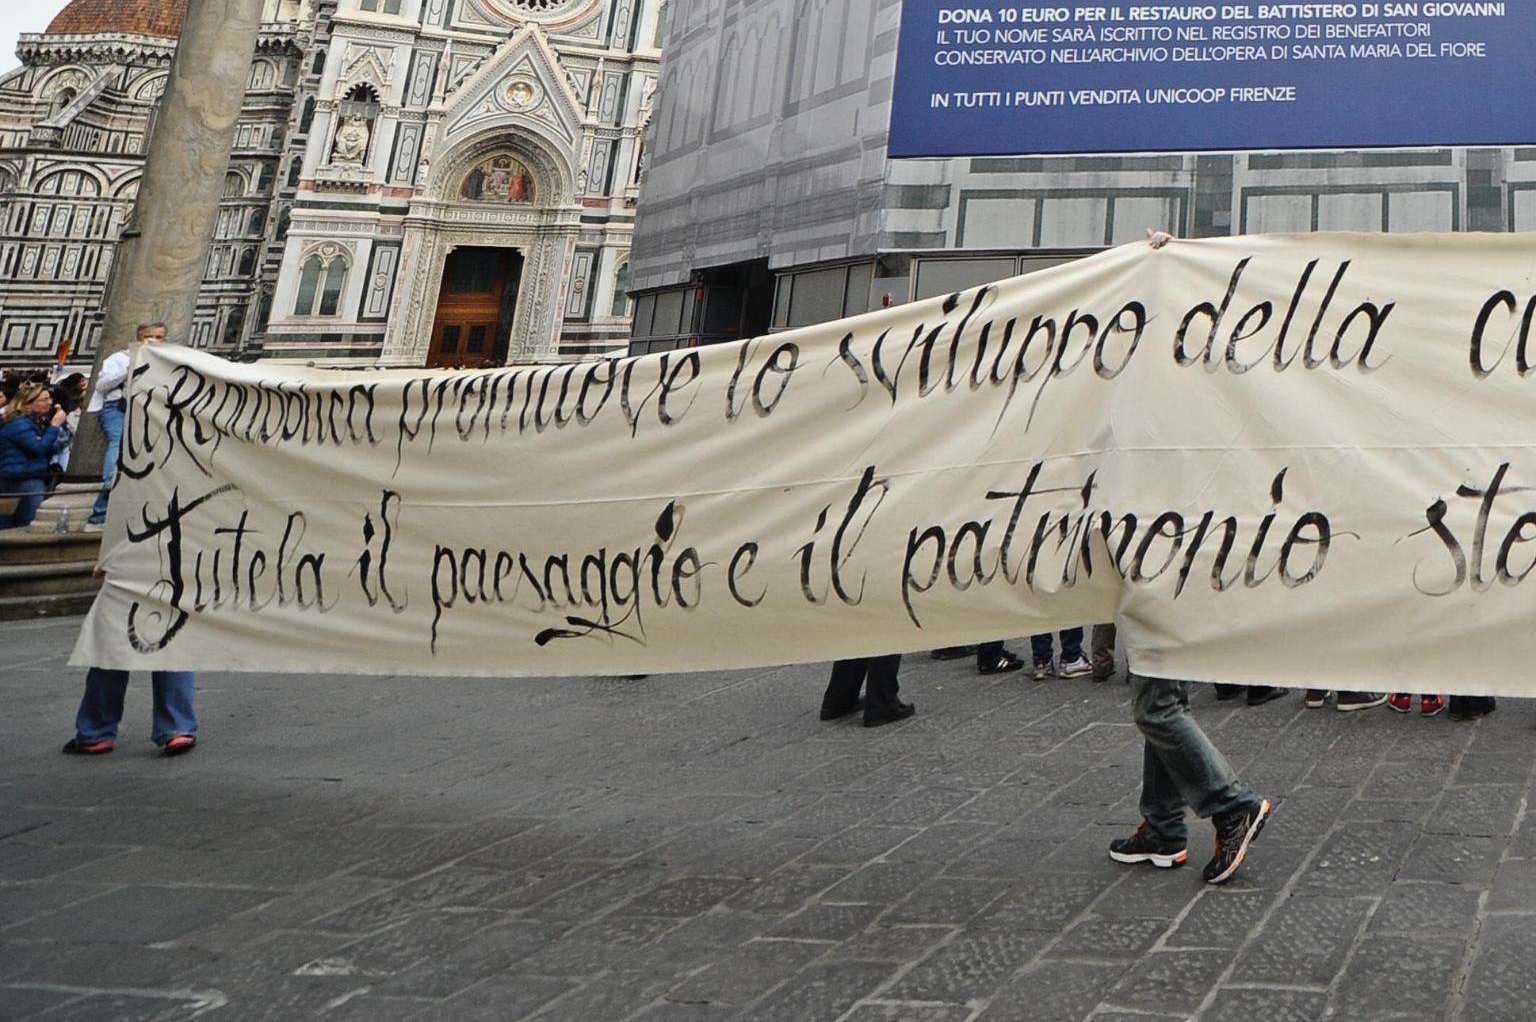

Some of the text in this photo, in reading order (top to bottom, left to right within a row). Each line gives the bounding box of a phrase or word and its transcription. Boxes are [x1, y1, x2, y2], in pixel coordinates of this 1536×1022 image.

[938, 2, 1505, 24] DONA 10 EURO PER IL RESTAURO DEL BATTISTERO DI SAN GIOVANNI
[936, 23, 1430, 45] IL TUO NOME SARÀ ISCRITTO NEL REGISTRO DEI BENEFATTORI
[934, 42, 1486, 66] CONSERVATO NELL'ARCHIVIO DELL'OPERA DI SANTA MARIA DEL FIORE
[930, 86, 1297, 108] IN TUTTI I PUNTI VENDITA UNICOOP FIRENZE
[725, 338, 806, 424] lo
[823, 284, 1156, 439] sviluppo
[1173, 256, 1396, 375] della
[126, 484, 339, 654] Tutela
[348, 489, 408, 614] il
[431, 500, 718, 656] paesaggio
[728, 541, 768, 608] e
[793, 464, 889, 606] il
[901, 460, 1360, 630] patrimonio
